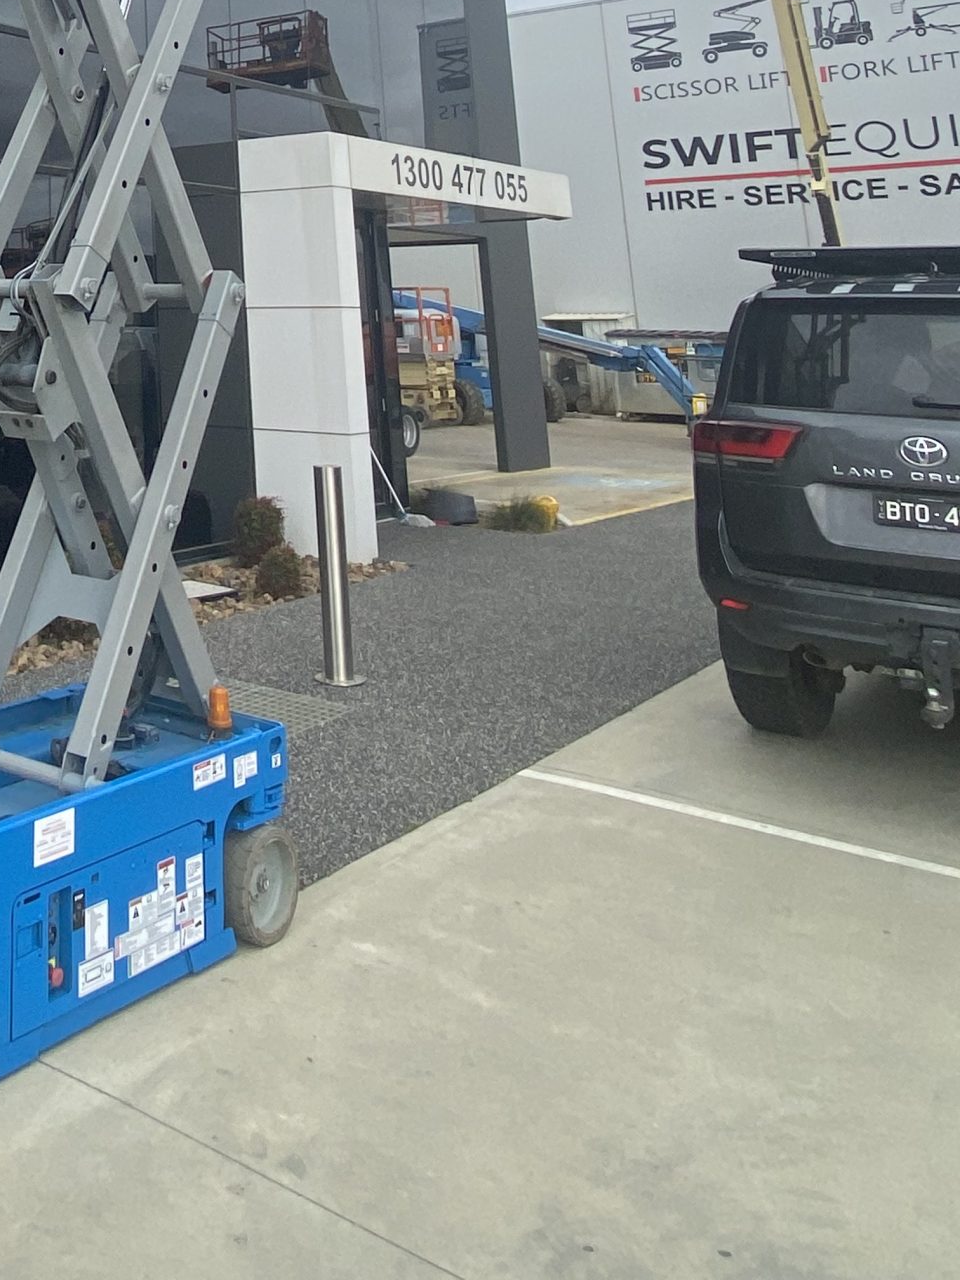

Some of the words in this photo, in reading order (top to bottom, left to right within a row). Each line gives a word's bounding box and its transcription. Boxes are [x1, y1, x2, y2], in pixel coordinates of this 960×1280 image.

[827, 57, 898, 82] FORK
[907, 50, 960, 74] LIFT
[641, 76, 739, 102] SCISSOR
[642, 127, 802, 169] SWIFT
[391, 153, 443, 191] 1300
[451, 163, 486, 197] 477
[494, 171, 528, 202] 055
[646, 188, 717, 211] HIRE
[743, 178, 889, 206] SERICE
[832, 465, 894, 479] LAND
[885, 500, 960, 527] BTO-4
